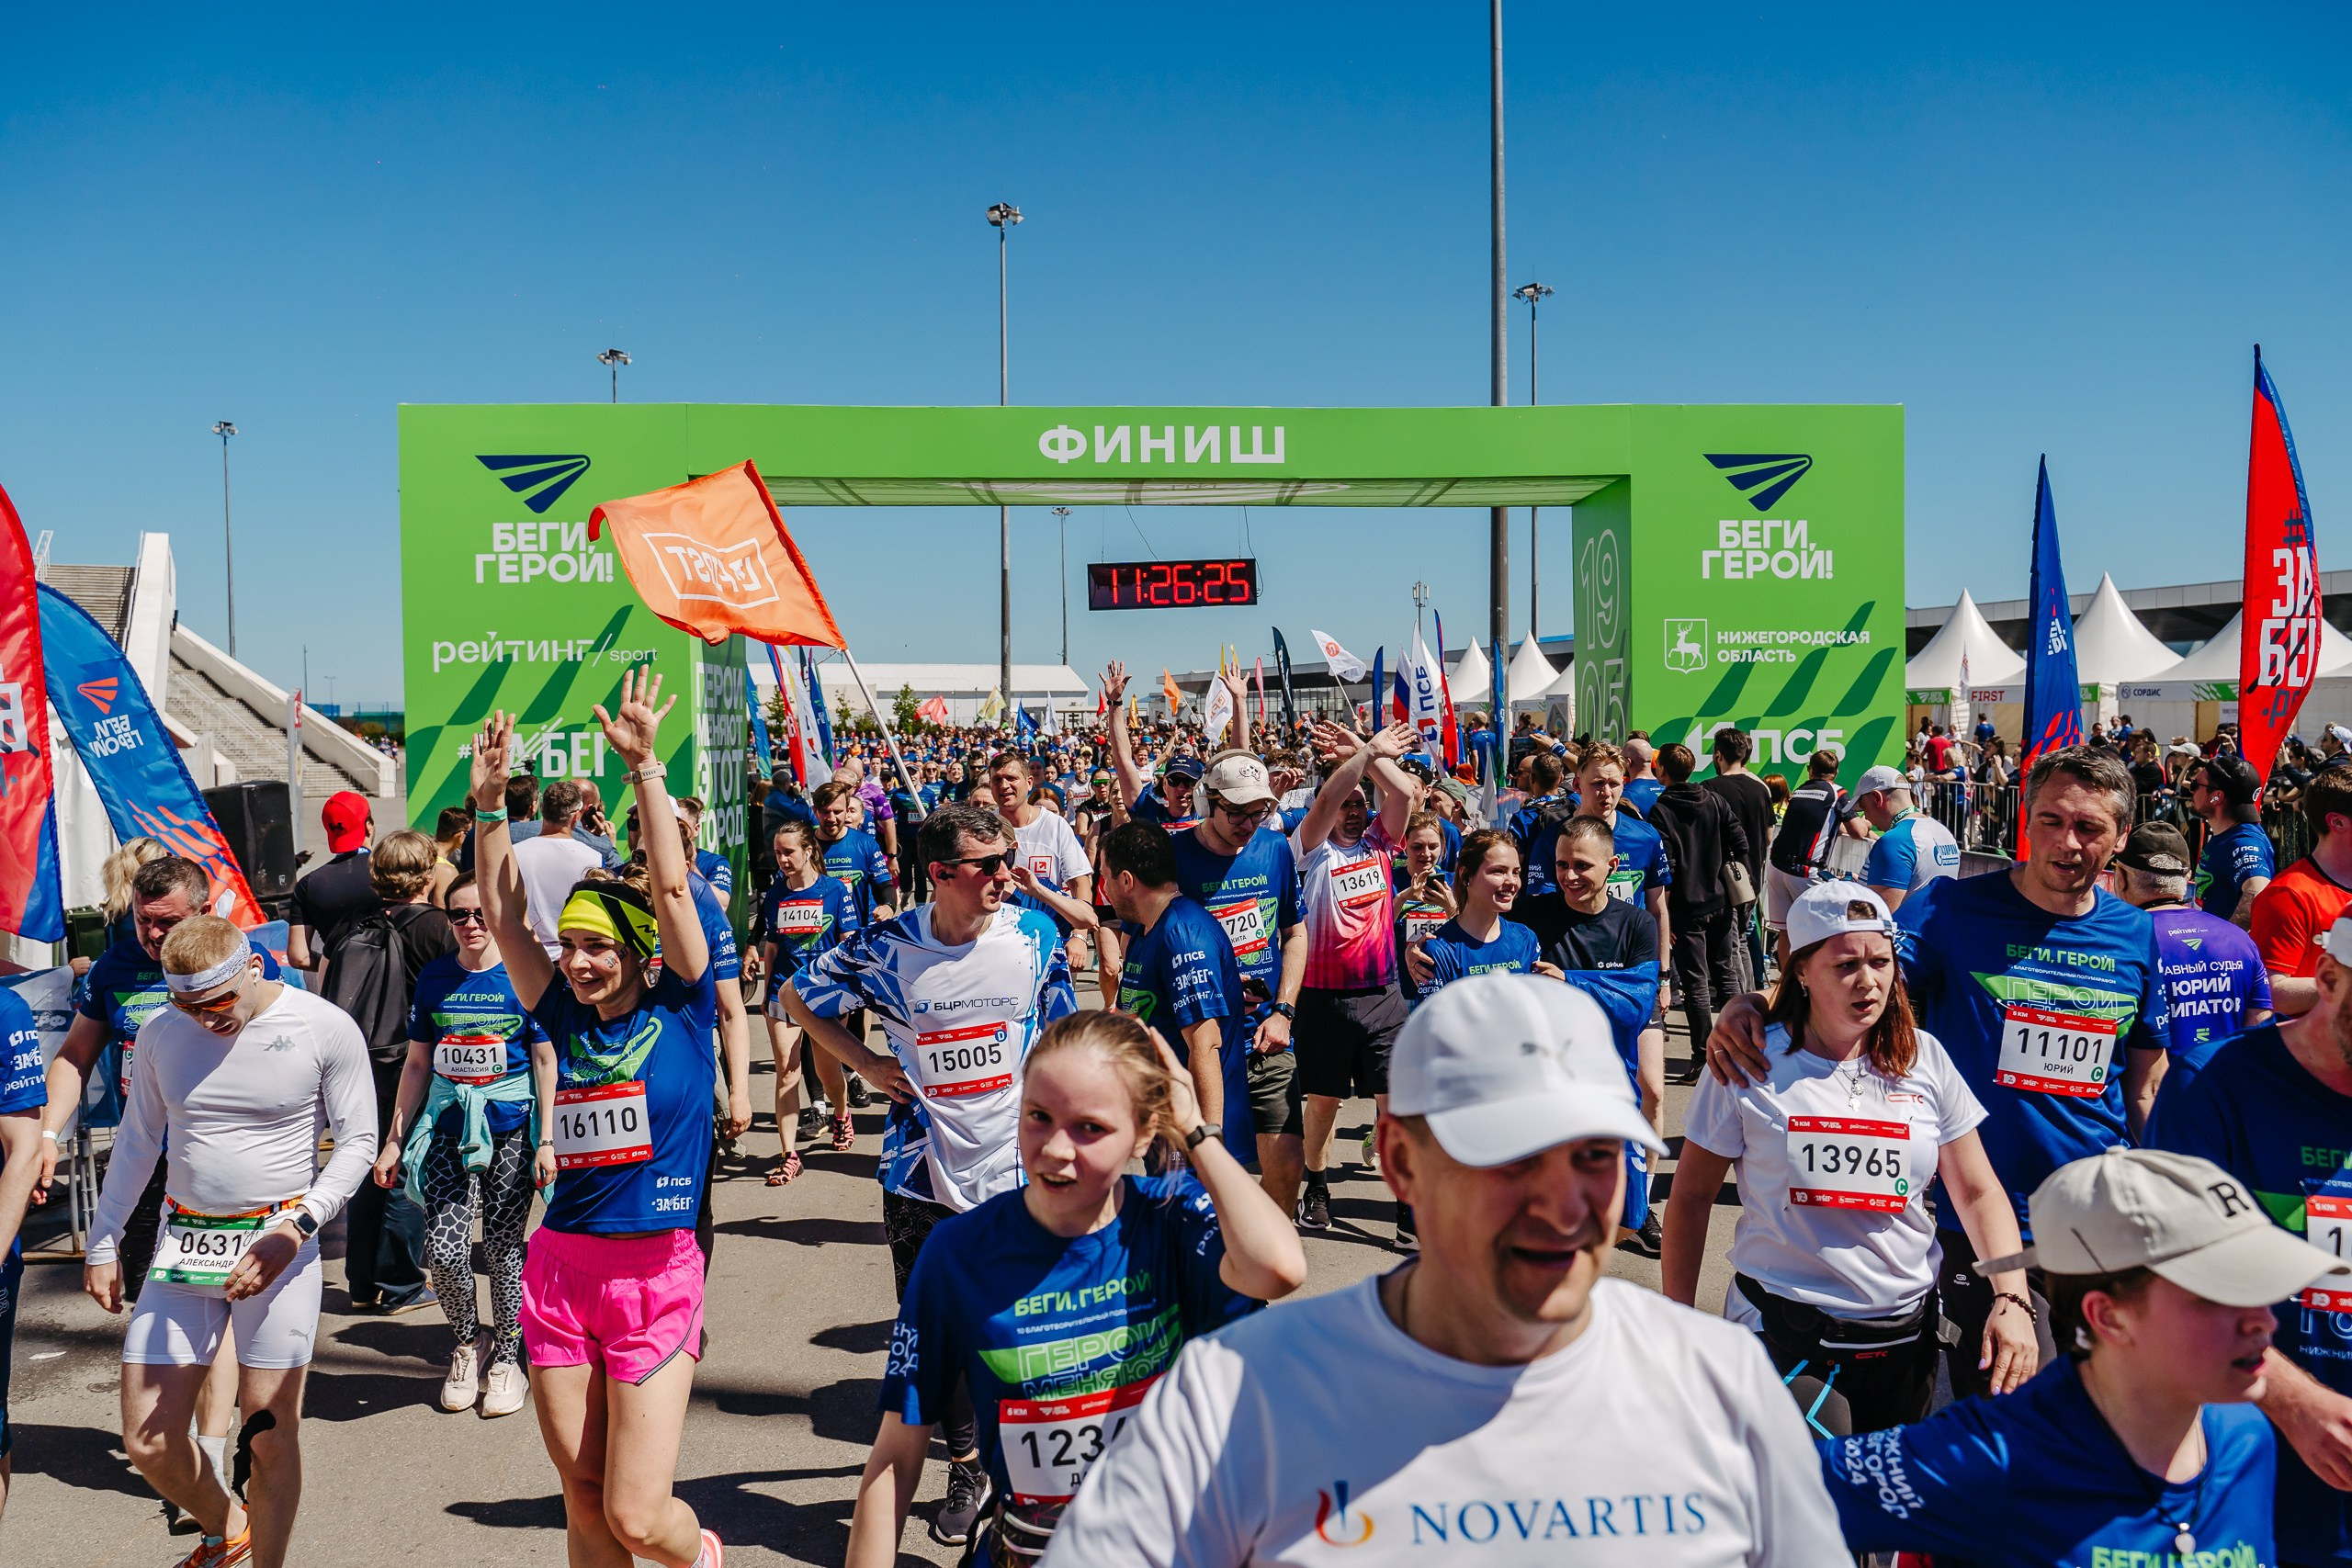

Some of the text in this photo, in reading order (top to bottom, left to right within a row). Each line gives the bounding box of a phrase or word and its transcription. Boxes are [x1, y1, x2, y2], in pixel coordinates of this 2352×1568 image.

[1038, 425, 1285, 464] ФИНИШ
[492, 522, 595, 555] БЕГИ,
[1718, 520, 1816, 552] БЕГИ,
[475, 547, 615, 584] ГЕРОЙ!
[1702, 546, 1834, 580] ГЕРОЙ!
[1112, 562, 1250, 605] 11:26:25
[1579, 528, 1620, 650] 19
[1717, 630, 1870, 646] НИЖЕГОРОДСКАЯ
[1716, 649, 1796, 663] ОБЛАСТЬ
[695, 661, 743, 711] ГЕРОИ
[1971, 691, 2005, 702] FIRST
[2132, 688, 2162, 697] СОРДИС
[696, 713, 743, 748] МЕНЯЮТ
[696, 749, 744, 805] ЭТОТ
[1340, 870, 1380, 892] 13619
[782, 909, 819, 922] 14104
[1231, 934, 1247, 944] КИТА
[1183, 951, 1206, 963] ПСБ
[2007, 943, 2116, 973] БЕГИ, ГЕРОЙ!
[2164, 960, 2244, 976] АВНЫЙ СУДЬЯ
[469, 992, 504, 1003] ГЕРОЙ!
[2007, 976, 2119, 1015] ГЕРОИ
[2171, 973, 2231, 997] ЮРИЙ
[933, 997, 1019, 1011] БЦРМОТОРС
[2170, 998, 2242, 1019] ИПАТОВ
[441, 1047, 498, 1065] 10431
[929, 1043, 1002, 1073] 15005
[2017, 1028, 2102, 1064] 11101
[2043, 1063, 2075, 1075] ЮРИЙ
[560, 1106, 638, 1140] 16110
[1802, 1143, 1901, 1179] 13965
[670, 1177, 692, 1187] ПСБ
[2207, 1180, 2250, 1218] R
[180, 1231, 243, 1257] 0631
[179, 1258, 234, 1269] АЛЕКСАНДР
[1014, 1291, 1078, 1317] БЕГИ,
[1017, 1315, 1169, 1382] ГЕРОИ
[1410, 1491, 1706, 1545] NOVARTIS
